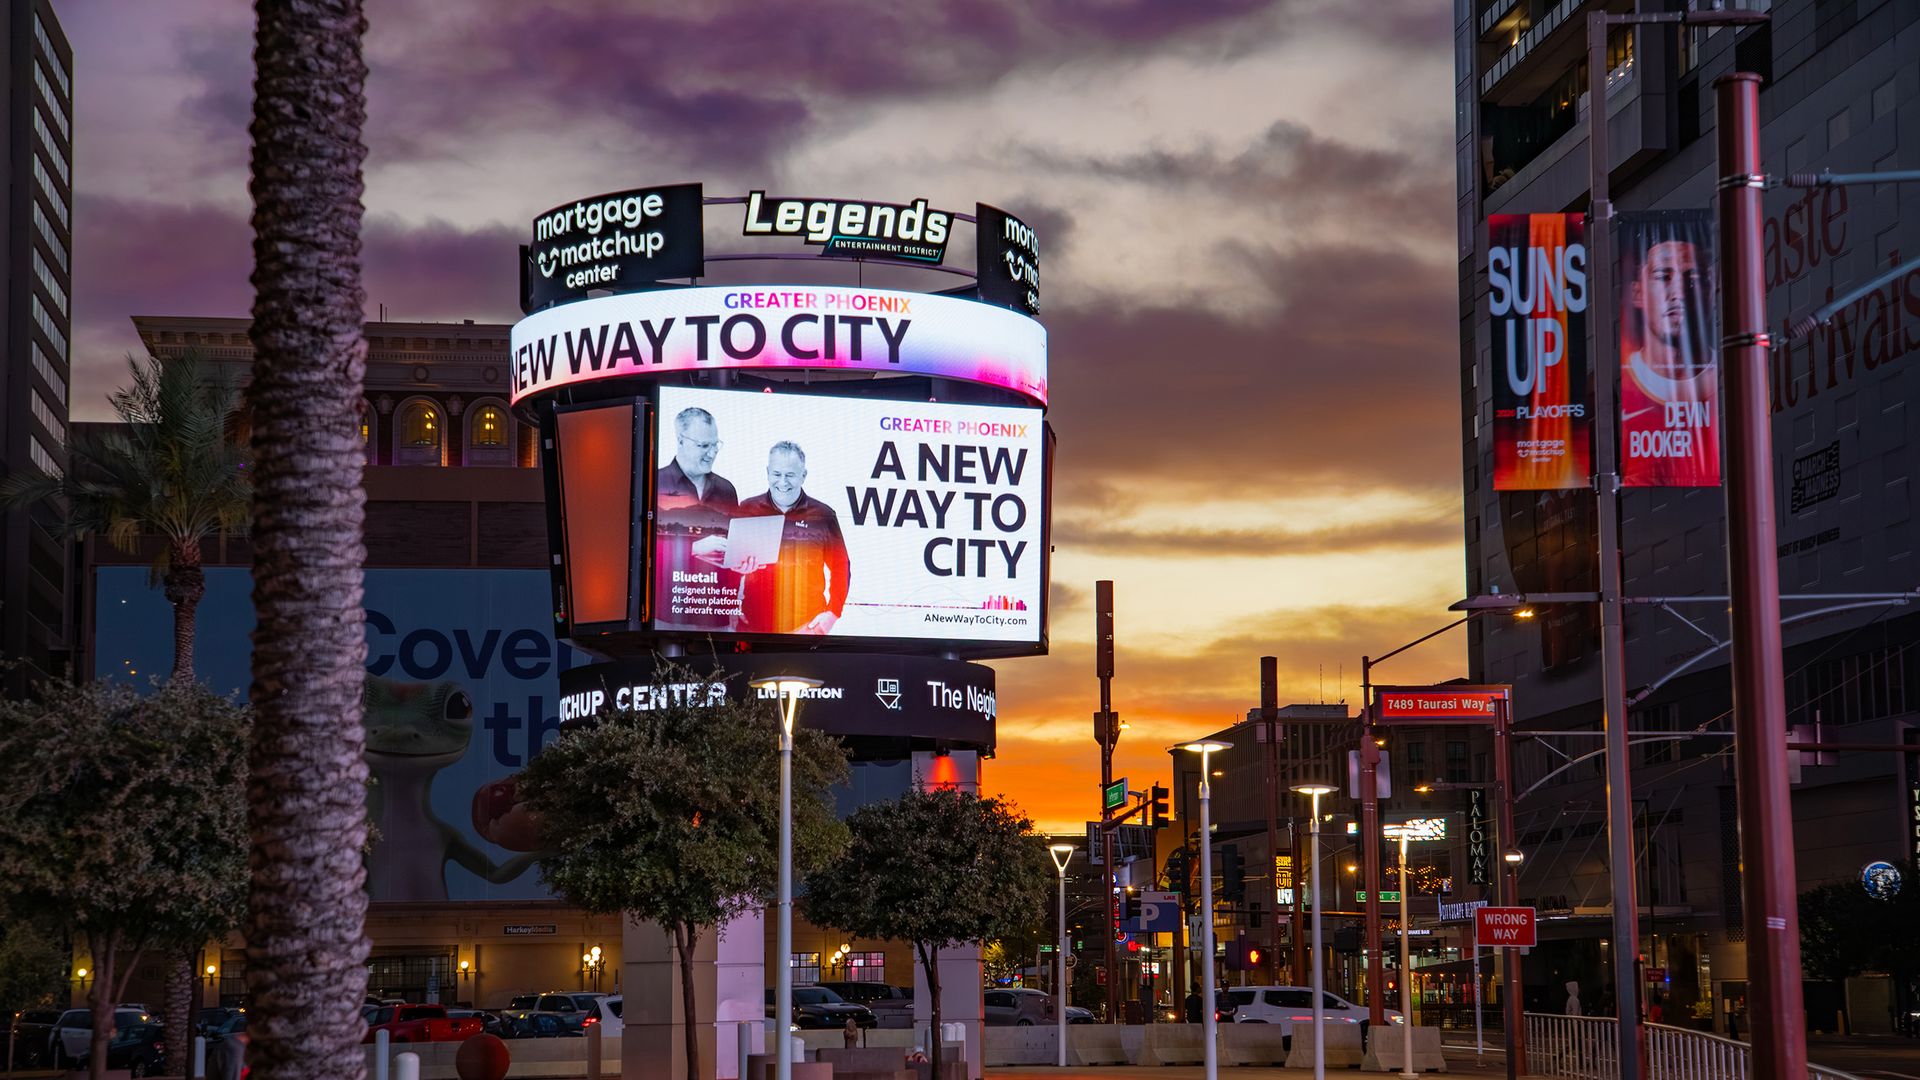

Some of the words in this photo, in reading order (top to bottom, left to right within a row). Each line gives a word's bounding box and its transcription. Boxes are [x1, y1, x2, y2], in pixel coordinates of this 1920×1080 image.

[537, 194, 664, 241] mortgage
[745, 192, 949, 244] Legends
[561, 230, 664, 267] matchup
[835, 240, 901, 252] ENTERTAINMENT
[904, 246, 937, 256] DISTRICT
[566, 264, 619, 288] center
[1488, 243, 1587, 316] SUNS
[724, 292, 818, 310] GREATER
[825, 294, 911, 314] PHOENIX
[565, 317, 676, 375] WAY
[685, 313, 767, 361] TO
[781, 313, 912, 364] CITY
[1506, 318, 1564, 396] UP
[1516, 404, 1585, 419] PLAYOFFS
[1664, 401, 1710, 428] DEVIN
[880, 416, 952, 434] GREATER
[957, 421, 1028, 438] PHOENIX
[1516, 440, 1565, 449] mortgage
[1630, 430, 1692, 458] BOOKER
[871, 441, 906, 481] A
[918, 442, 1028, 486] NEW
[846, 485, 957, 529] WAY
[964, 491, 1027, 533] TO
[923, 536, 1028, 579] CITY
[672, 571, 718, 584] Bluetail
[671, 586, 706, 596] designed
[707, 587, 721, 595] the
[721, 587, 737, 596] first
[671, 596, 707, 605] AI-driven
[708, 597, 742, 607] platform
[671, 605, 684, 614] for
[684, 606, 713, 615] aircraft
[713, 607, 744, 616] records.
[924, 613, 1027, 627] ANewWayToCity.com
[616, 682, 727, 712] CENTER
[797, 687, 843, 699] ATION
[927, 680, 963, 709] The
[1388, 699, 1414, 709] 7489
[1417, 698, 1457, 709] Taurasi
[1462, 699, 1485, 711] Way
[1470, 790, 1486, 883] PALOMAR
[1140, 903, 1160, 930] P
[1484, 913, 1528, 926] WRONG
[1493, 928, 1519, 940] WAY
